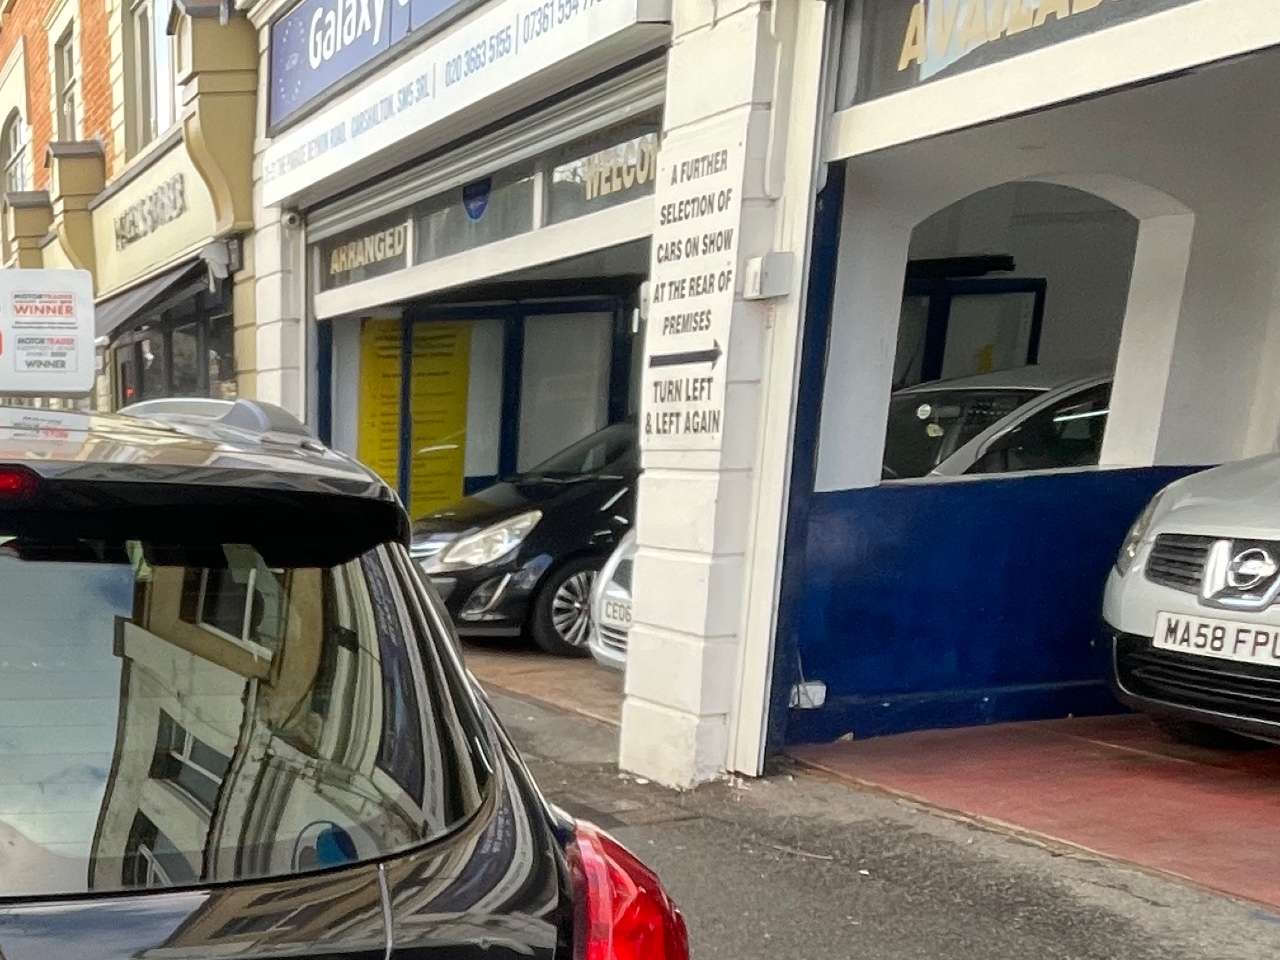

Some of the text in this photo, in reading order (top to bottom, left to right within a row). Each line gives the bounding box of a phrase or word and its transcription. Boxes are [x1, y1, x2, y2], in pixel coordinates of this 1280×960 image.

[309, 0, 385, 70] Galaxy
[445, 56, 462, 87] 020
[489, 25, 512, 63] 5155
[523, 0, 554, 44] 07361
[671, 149, 728, 186] A FURTHER
[660, 188, 733, 226] SELECTION OF
[330, 224, 405, 274] ARRANGED
[657, 228, 734, 264] CARS ON SHOW
[653, 269, 733, 303] AT THE REAR OF
[14, 304, 74, 316] WINNER
[662, 309, 712, 336] PREMISES
[653, 376, 714, 403] TURN LEFT
[645, 409, 721, 435] & LEFT AGAIN
[1164, 617, 1226, 652] MA58
